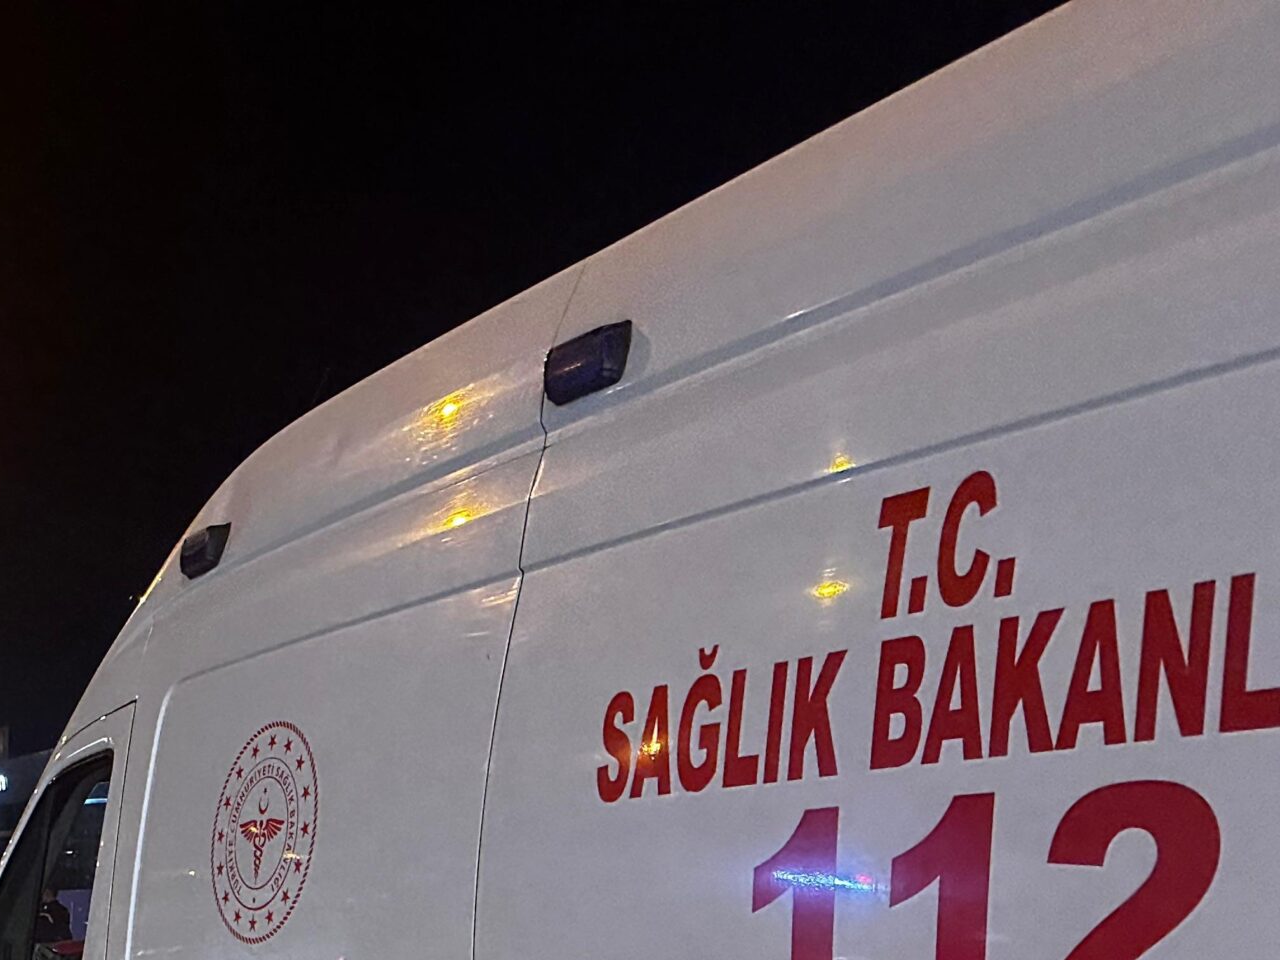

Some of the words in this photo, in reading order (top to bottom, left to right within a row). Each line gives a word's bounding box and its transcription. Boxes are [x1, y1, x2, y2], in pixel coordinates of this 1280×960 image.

[877, 470, 1017, 619] T.C.
[596, 644, 847, 804] SAĞLIK
[869, 572, 1280, 771] BAKANL
[275, 765, 295, 806] SAĞLIK
